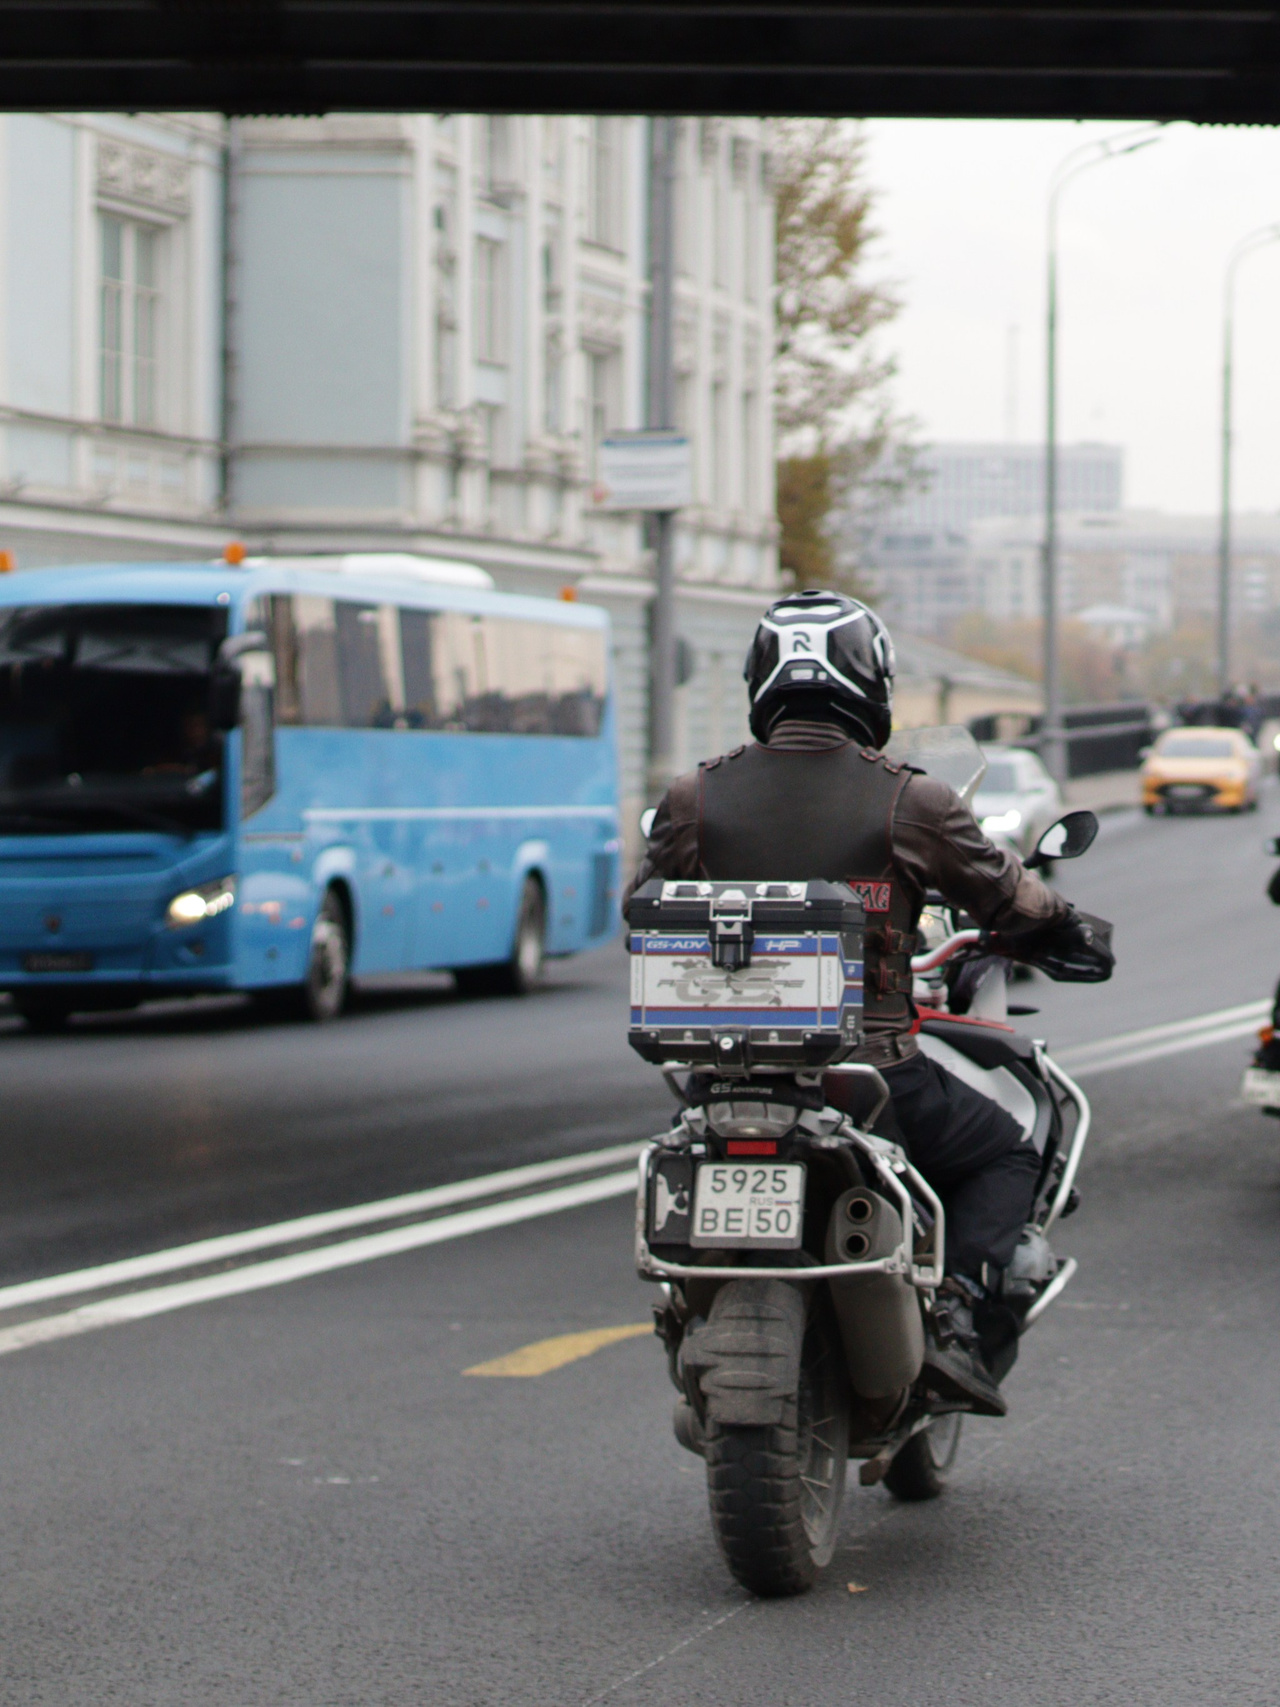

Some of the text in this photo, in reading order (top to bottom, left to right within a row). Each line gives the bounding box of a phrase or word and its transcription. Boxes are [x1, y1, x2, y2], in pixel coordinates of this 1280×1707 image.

[646, 940, 706, 950] GS-ADV
[765, 939, 802, 952] HP
[710, 1082, 732, 1094] GS
[710, 1169, 788, 1194] 5925
[749, 1196, 774, 1206] RUS
[755, 1209, 792, 1233] 50
